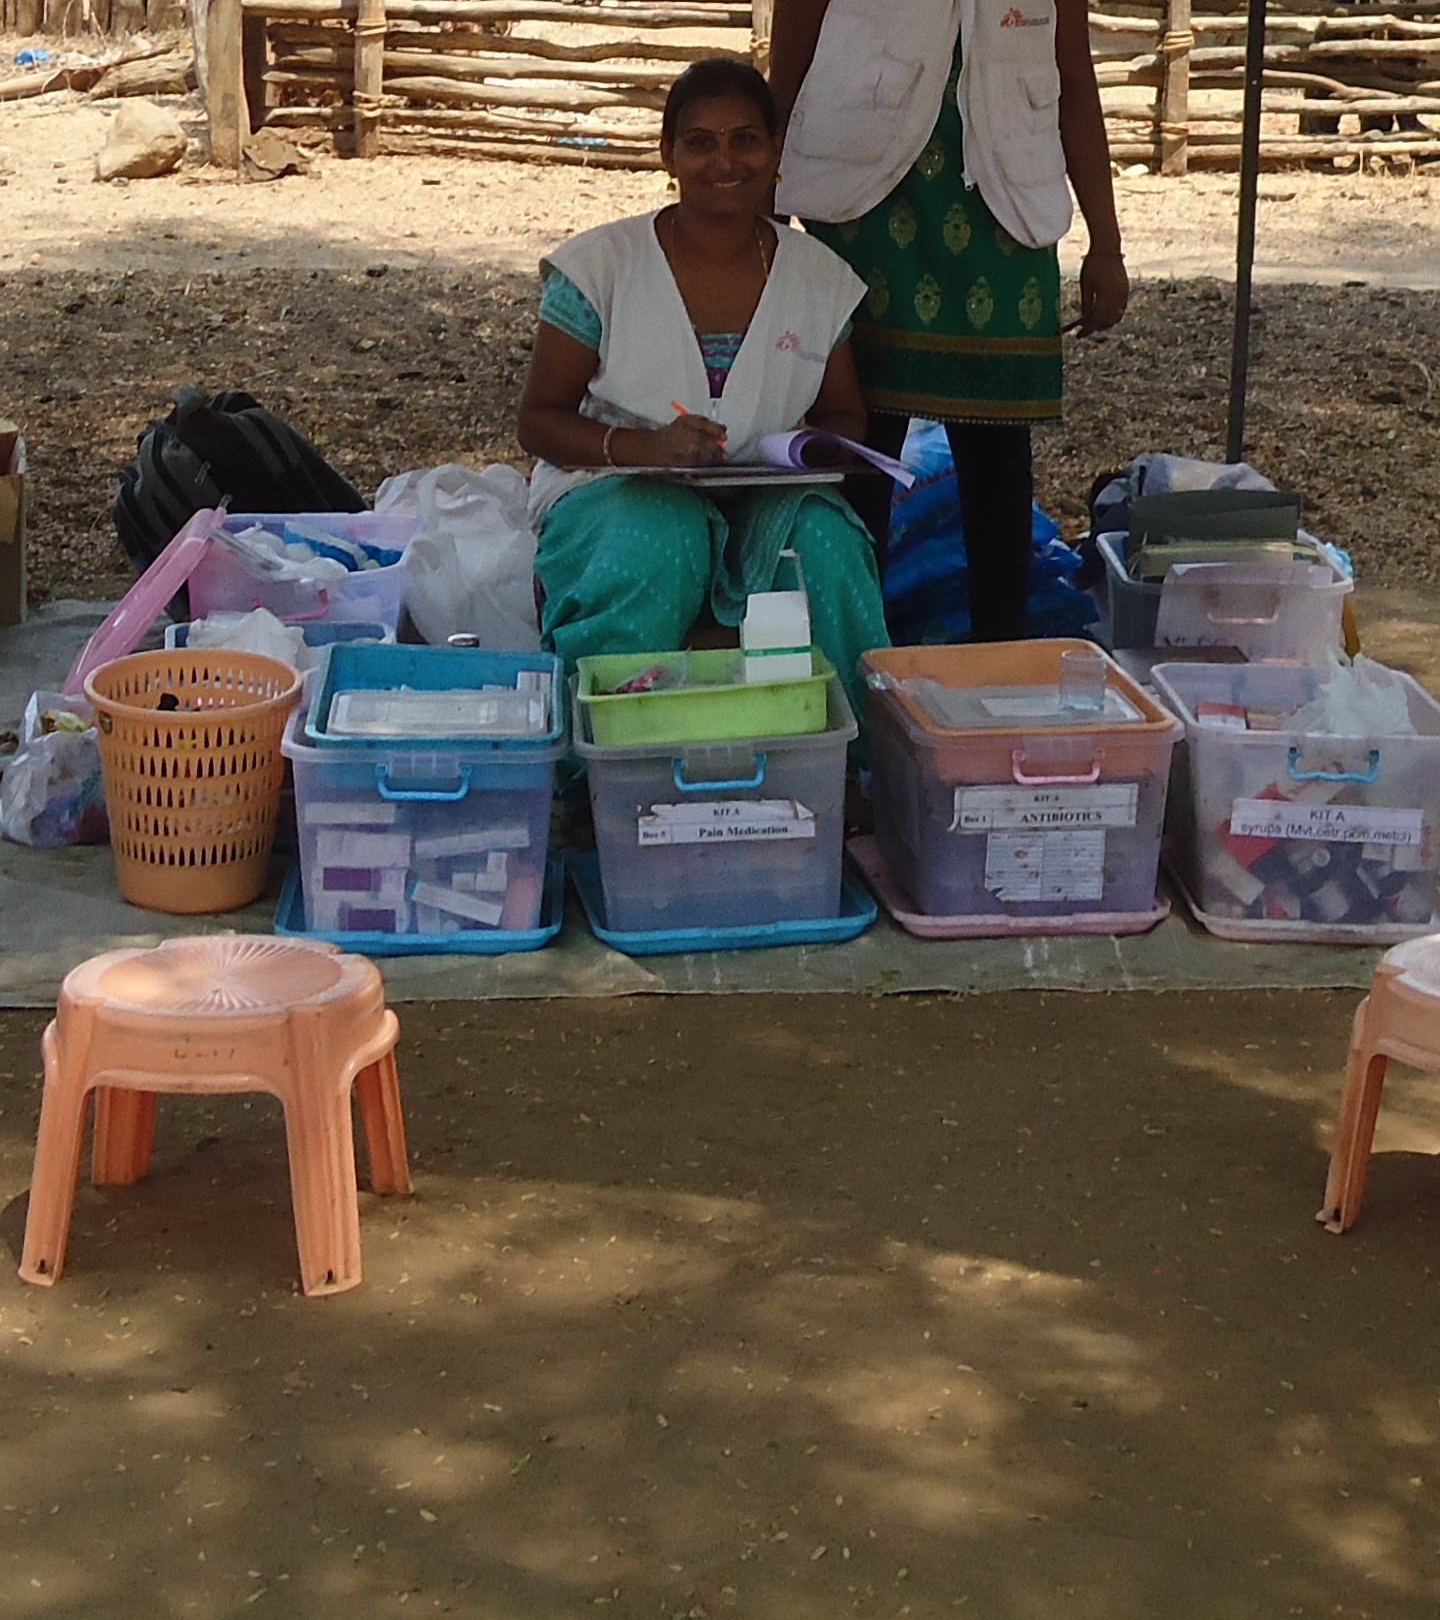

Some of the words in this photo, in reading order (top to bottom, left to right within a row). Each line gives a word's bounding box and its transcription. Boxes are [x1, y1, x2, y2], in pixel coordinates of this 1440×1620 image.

[1021, 811, 1103, 824] ANTIBIOTICS
[1310, 809, 1331, 821] KIT
[1335, 811, 1346, 822] A
[698, 827, 724, 838] Pain
[727, 825, 788, 837] Medication
[1240, 822, 1282, 835] syrups
